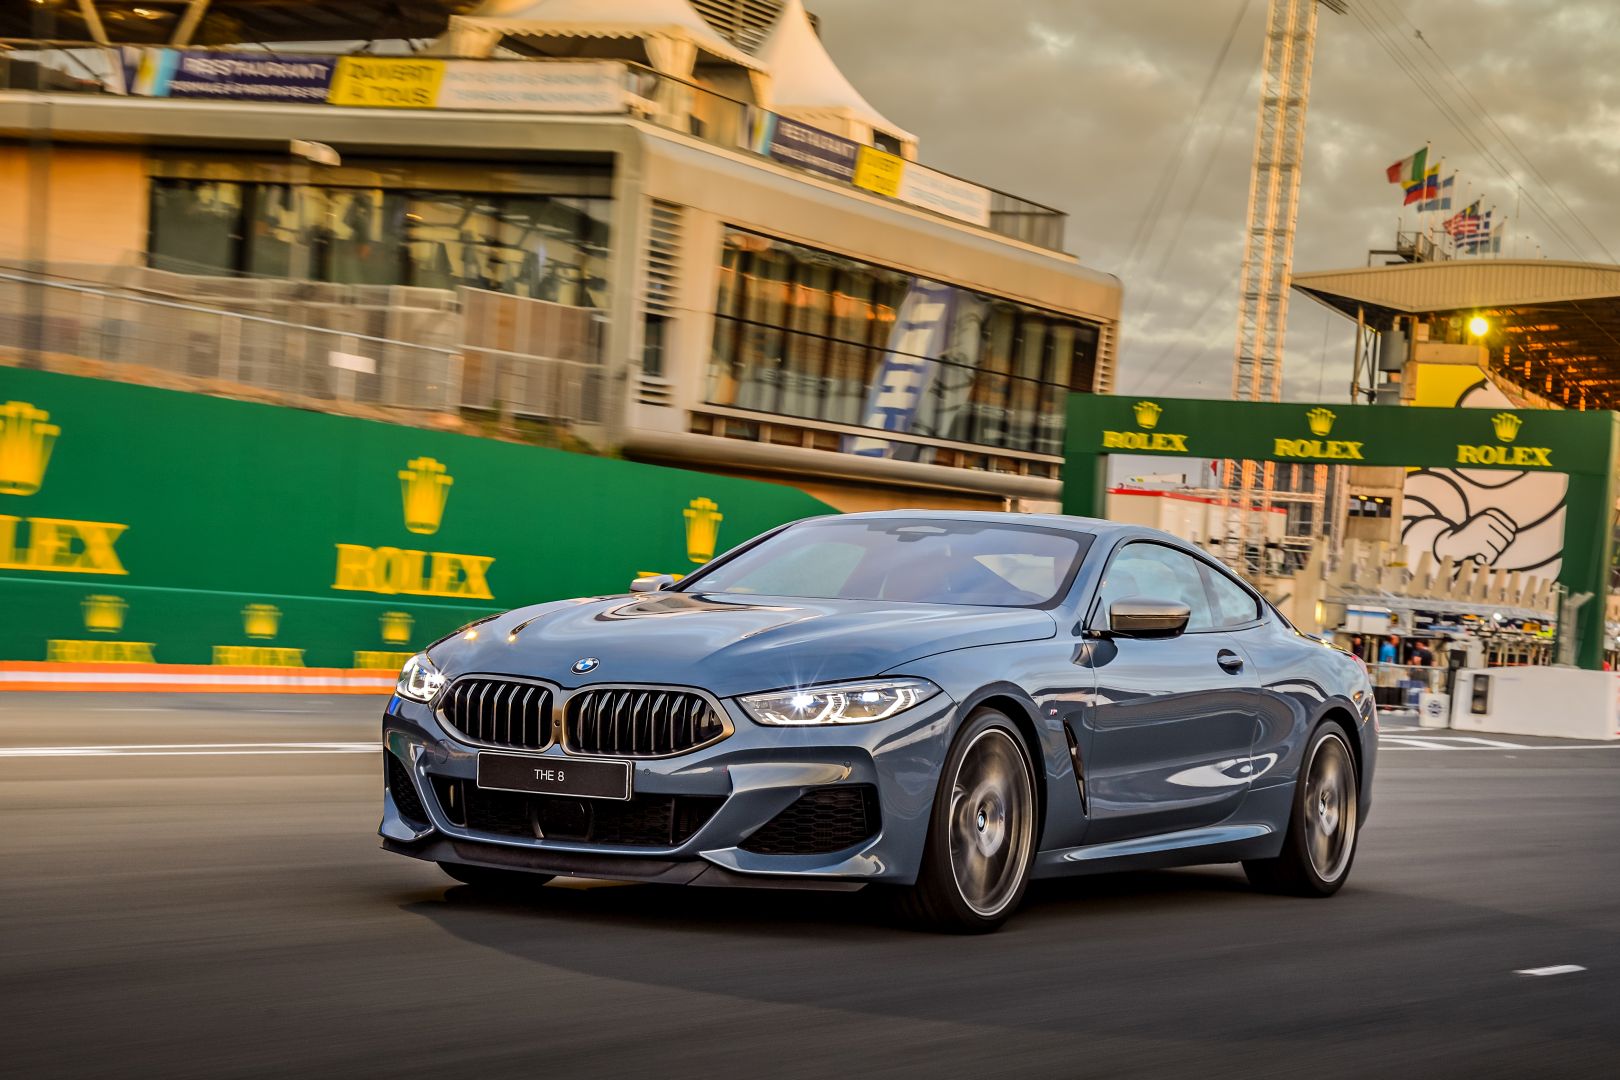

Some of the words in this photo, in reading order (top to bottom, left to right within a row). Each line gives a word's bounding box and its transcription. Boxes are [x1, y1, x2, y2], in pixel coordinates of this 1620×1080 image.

[1103, 430, 1189, 452] ROLEX
[1274, 438, 1365, 460] ROLEX
[1456, 444, 1553, 467] ROLEX
[331, 543, 496, 599] ROLEX
[534, 769, 554, 781] THE
[557, 770, 565, 782] 8
